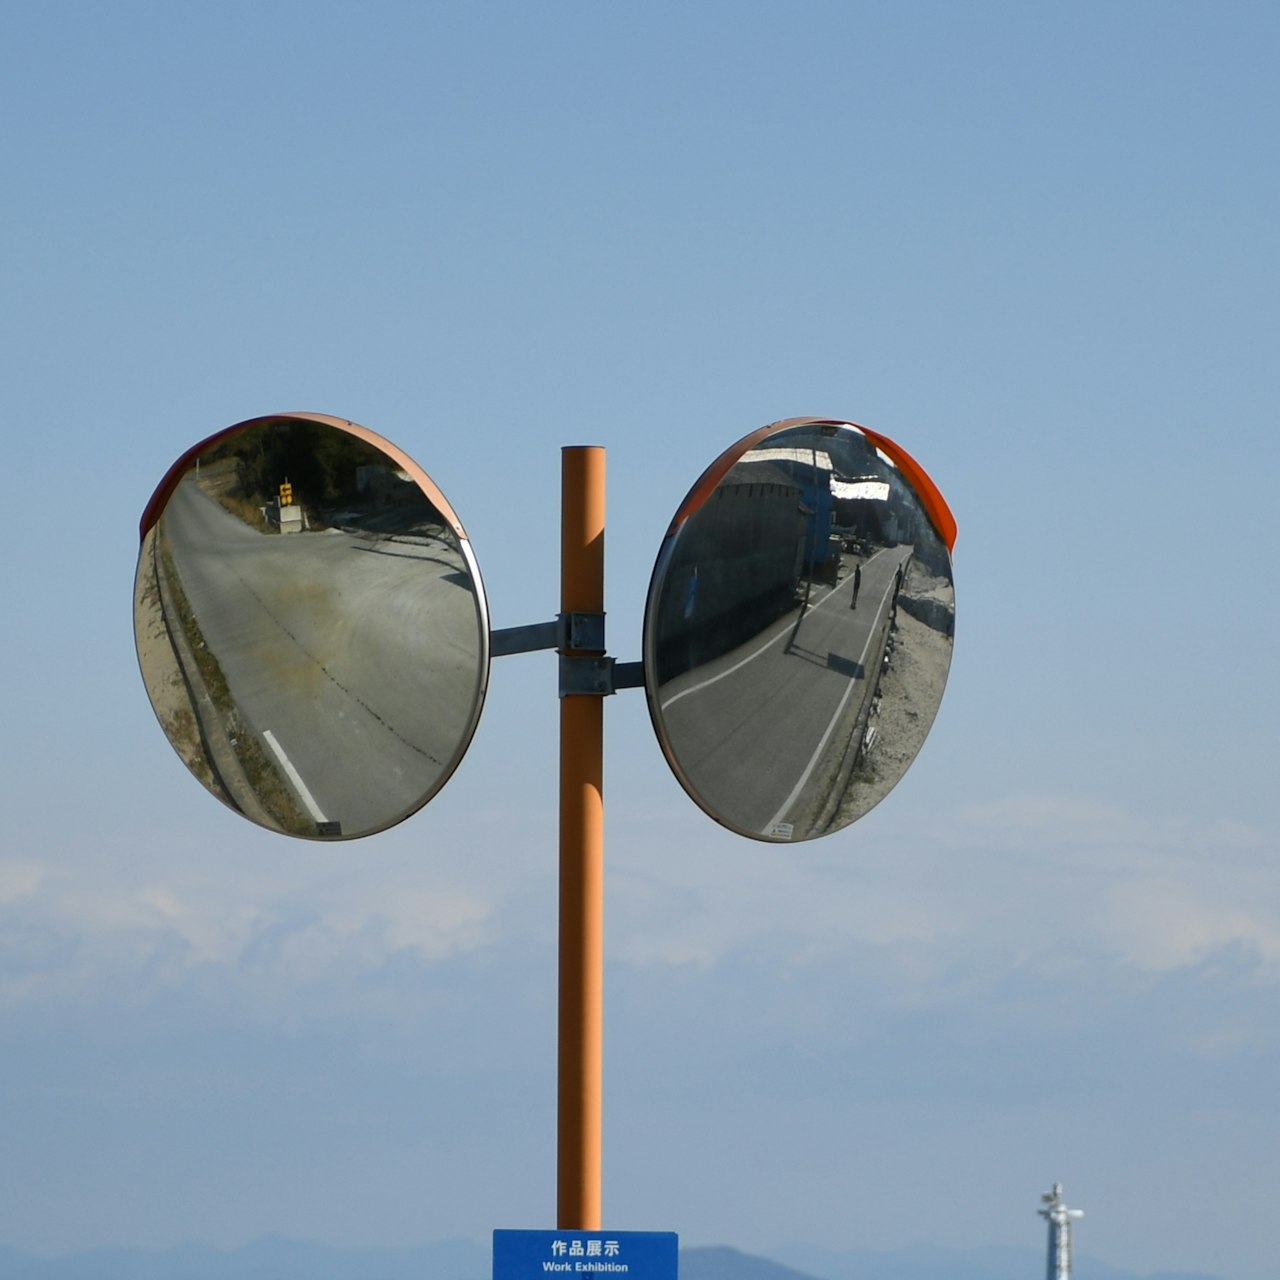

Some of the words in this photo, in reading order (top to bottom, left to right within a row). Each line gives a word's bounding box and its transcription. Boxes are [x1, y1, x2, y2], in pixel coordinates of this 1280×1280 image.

[551, 1240, 620, 1257] 作品展示
[542, 1261, 572, 1272] Work
[575, 1261, 629, 1272] Exhibition
